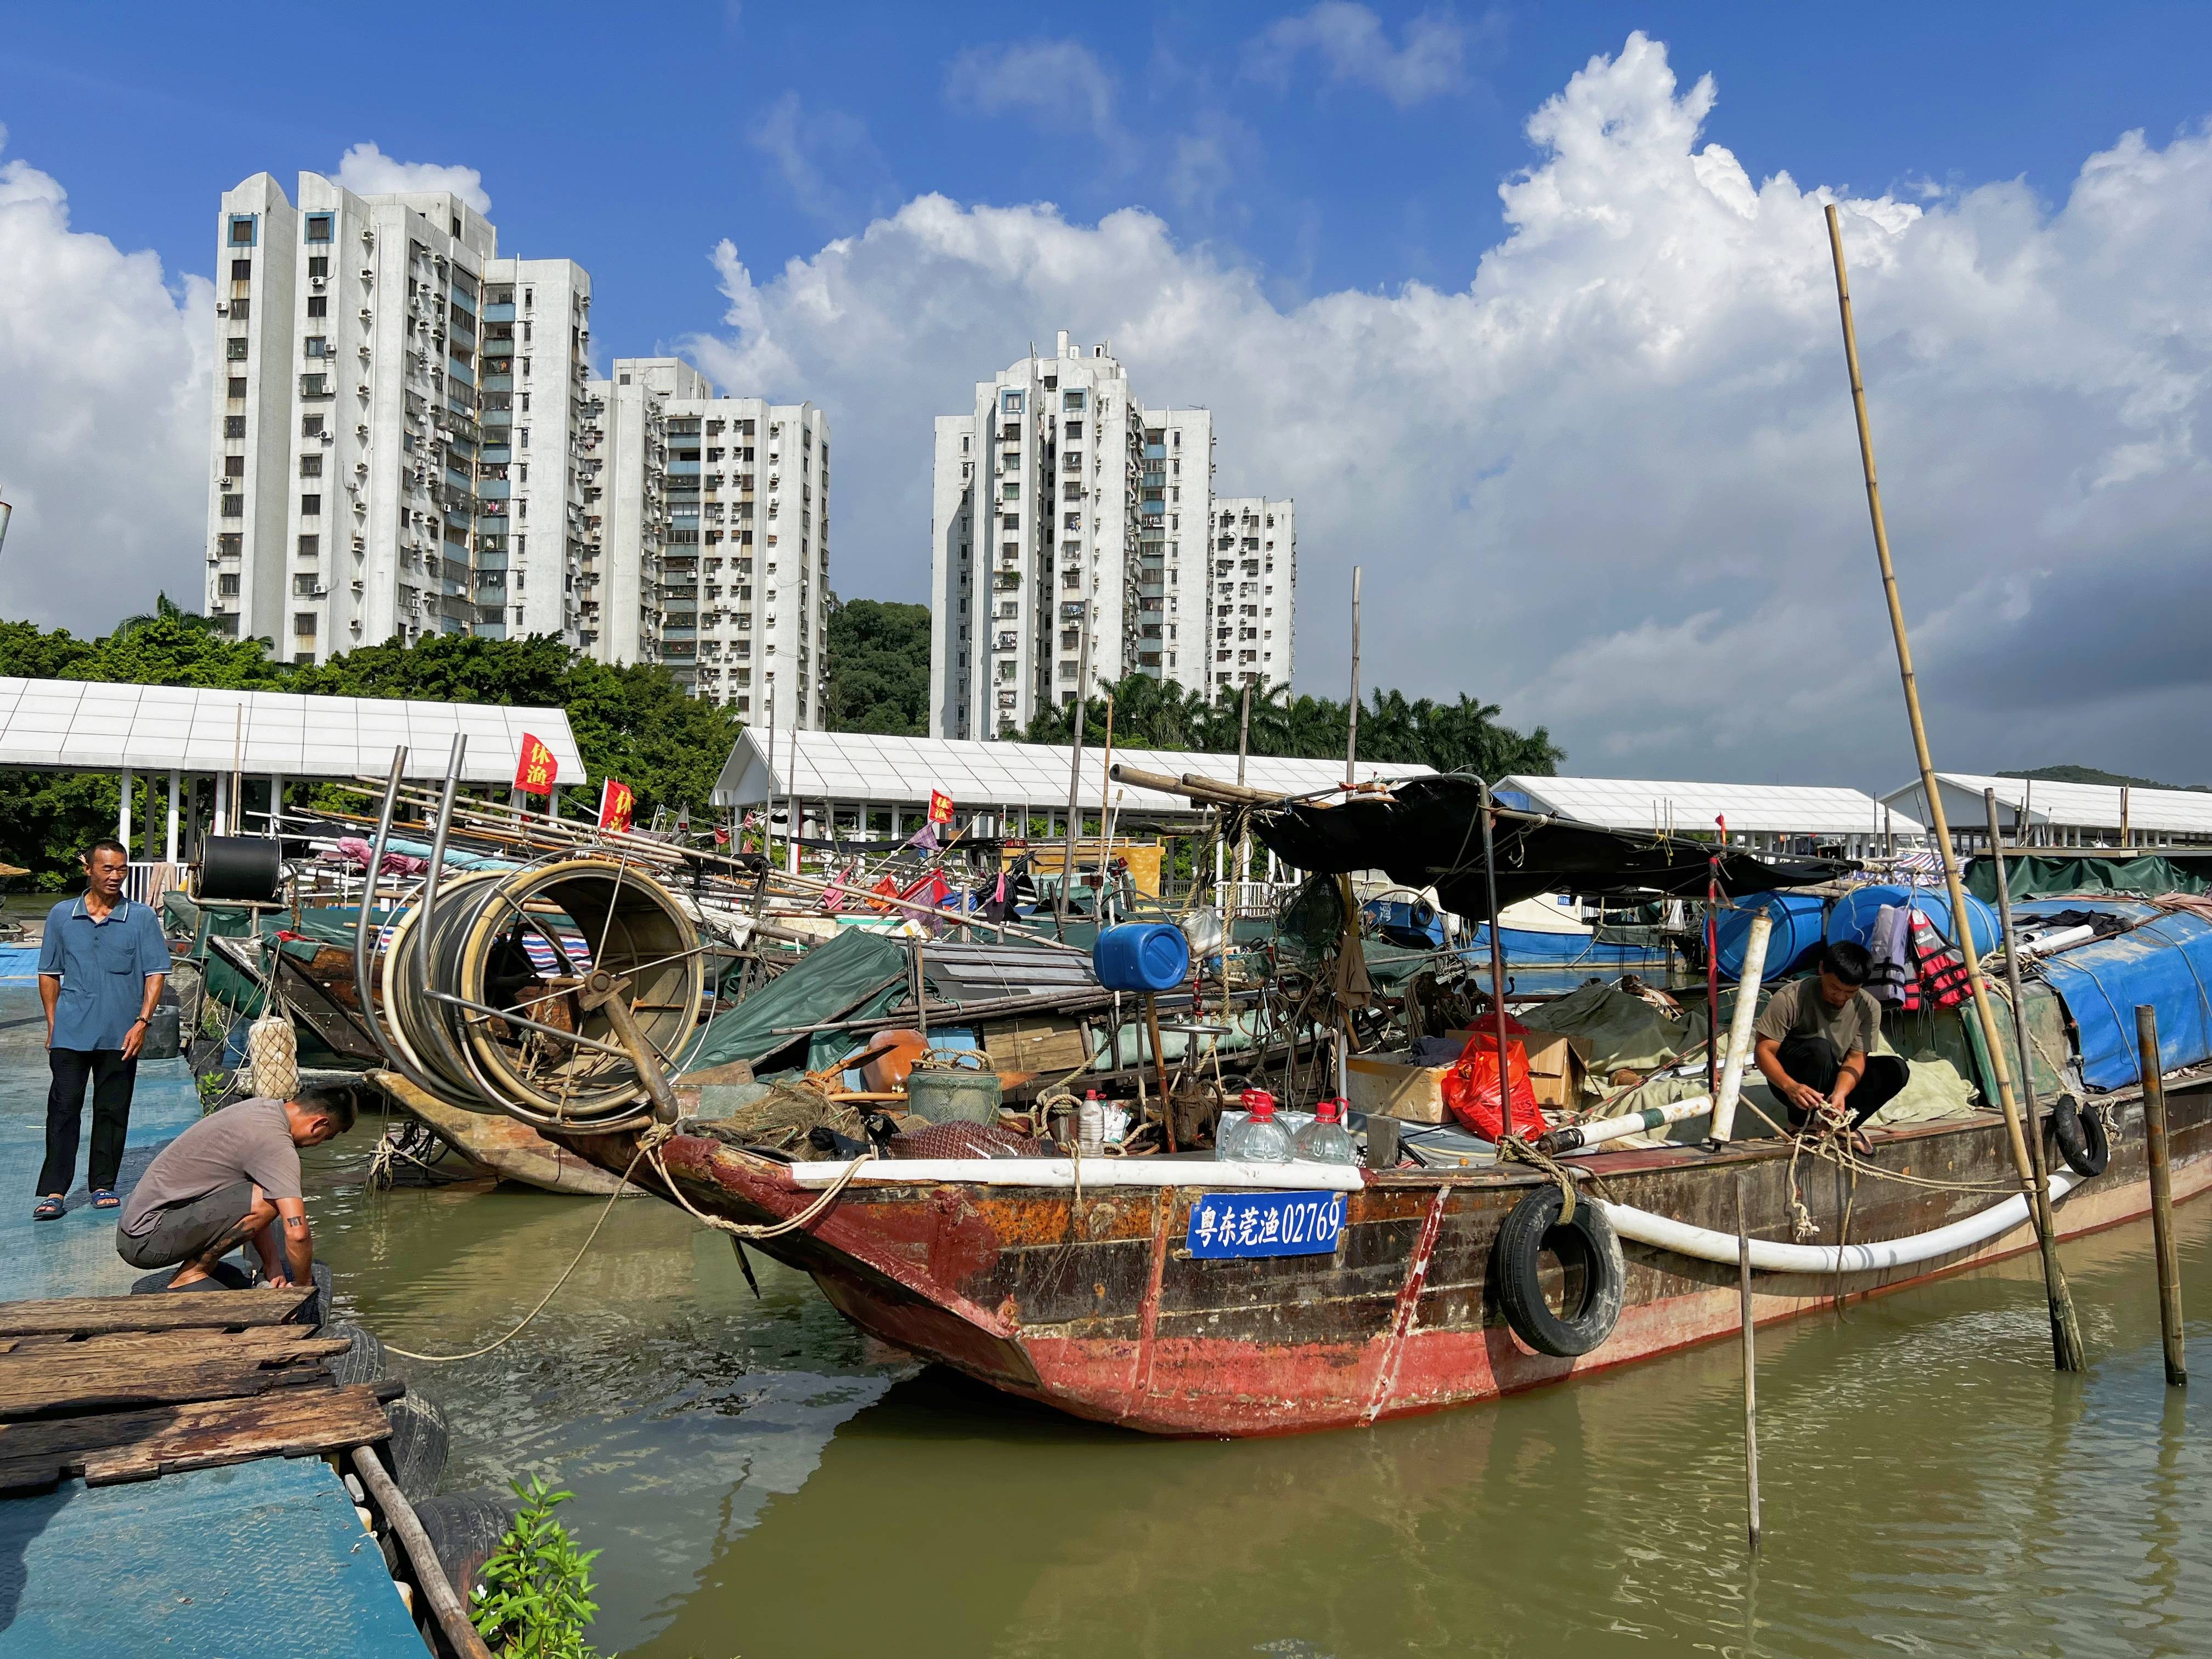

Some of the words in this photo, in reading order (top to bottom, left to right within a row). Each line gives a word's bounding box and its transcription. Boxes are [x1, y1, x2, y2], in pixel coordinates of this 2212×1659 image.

[527, 742, 551, 786] 休渔
[1194, 1201, 1340, 1248] 粤东莞渔02769
